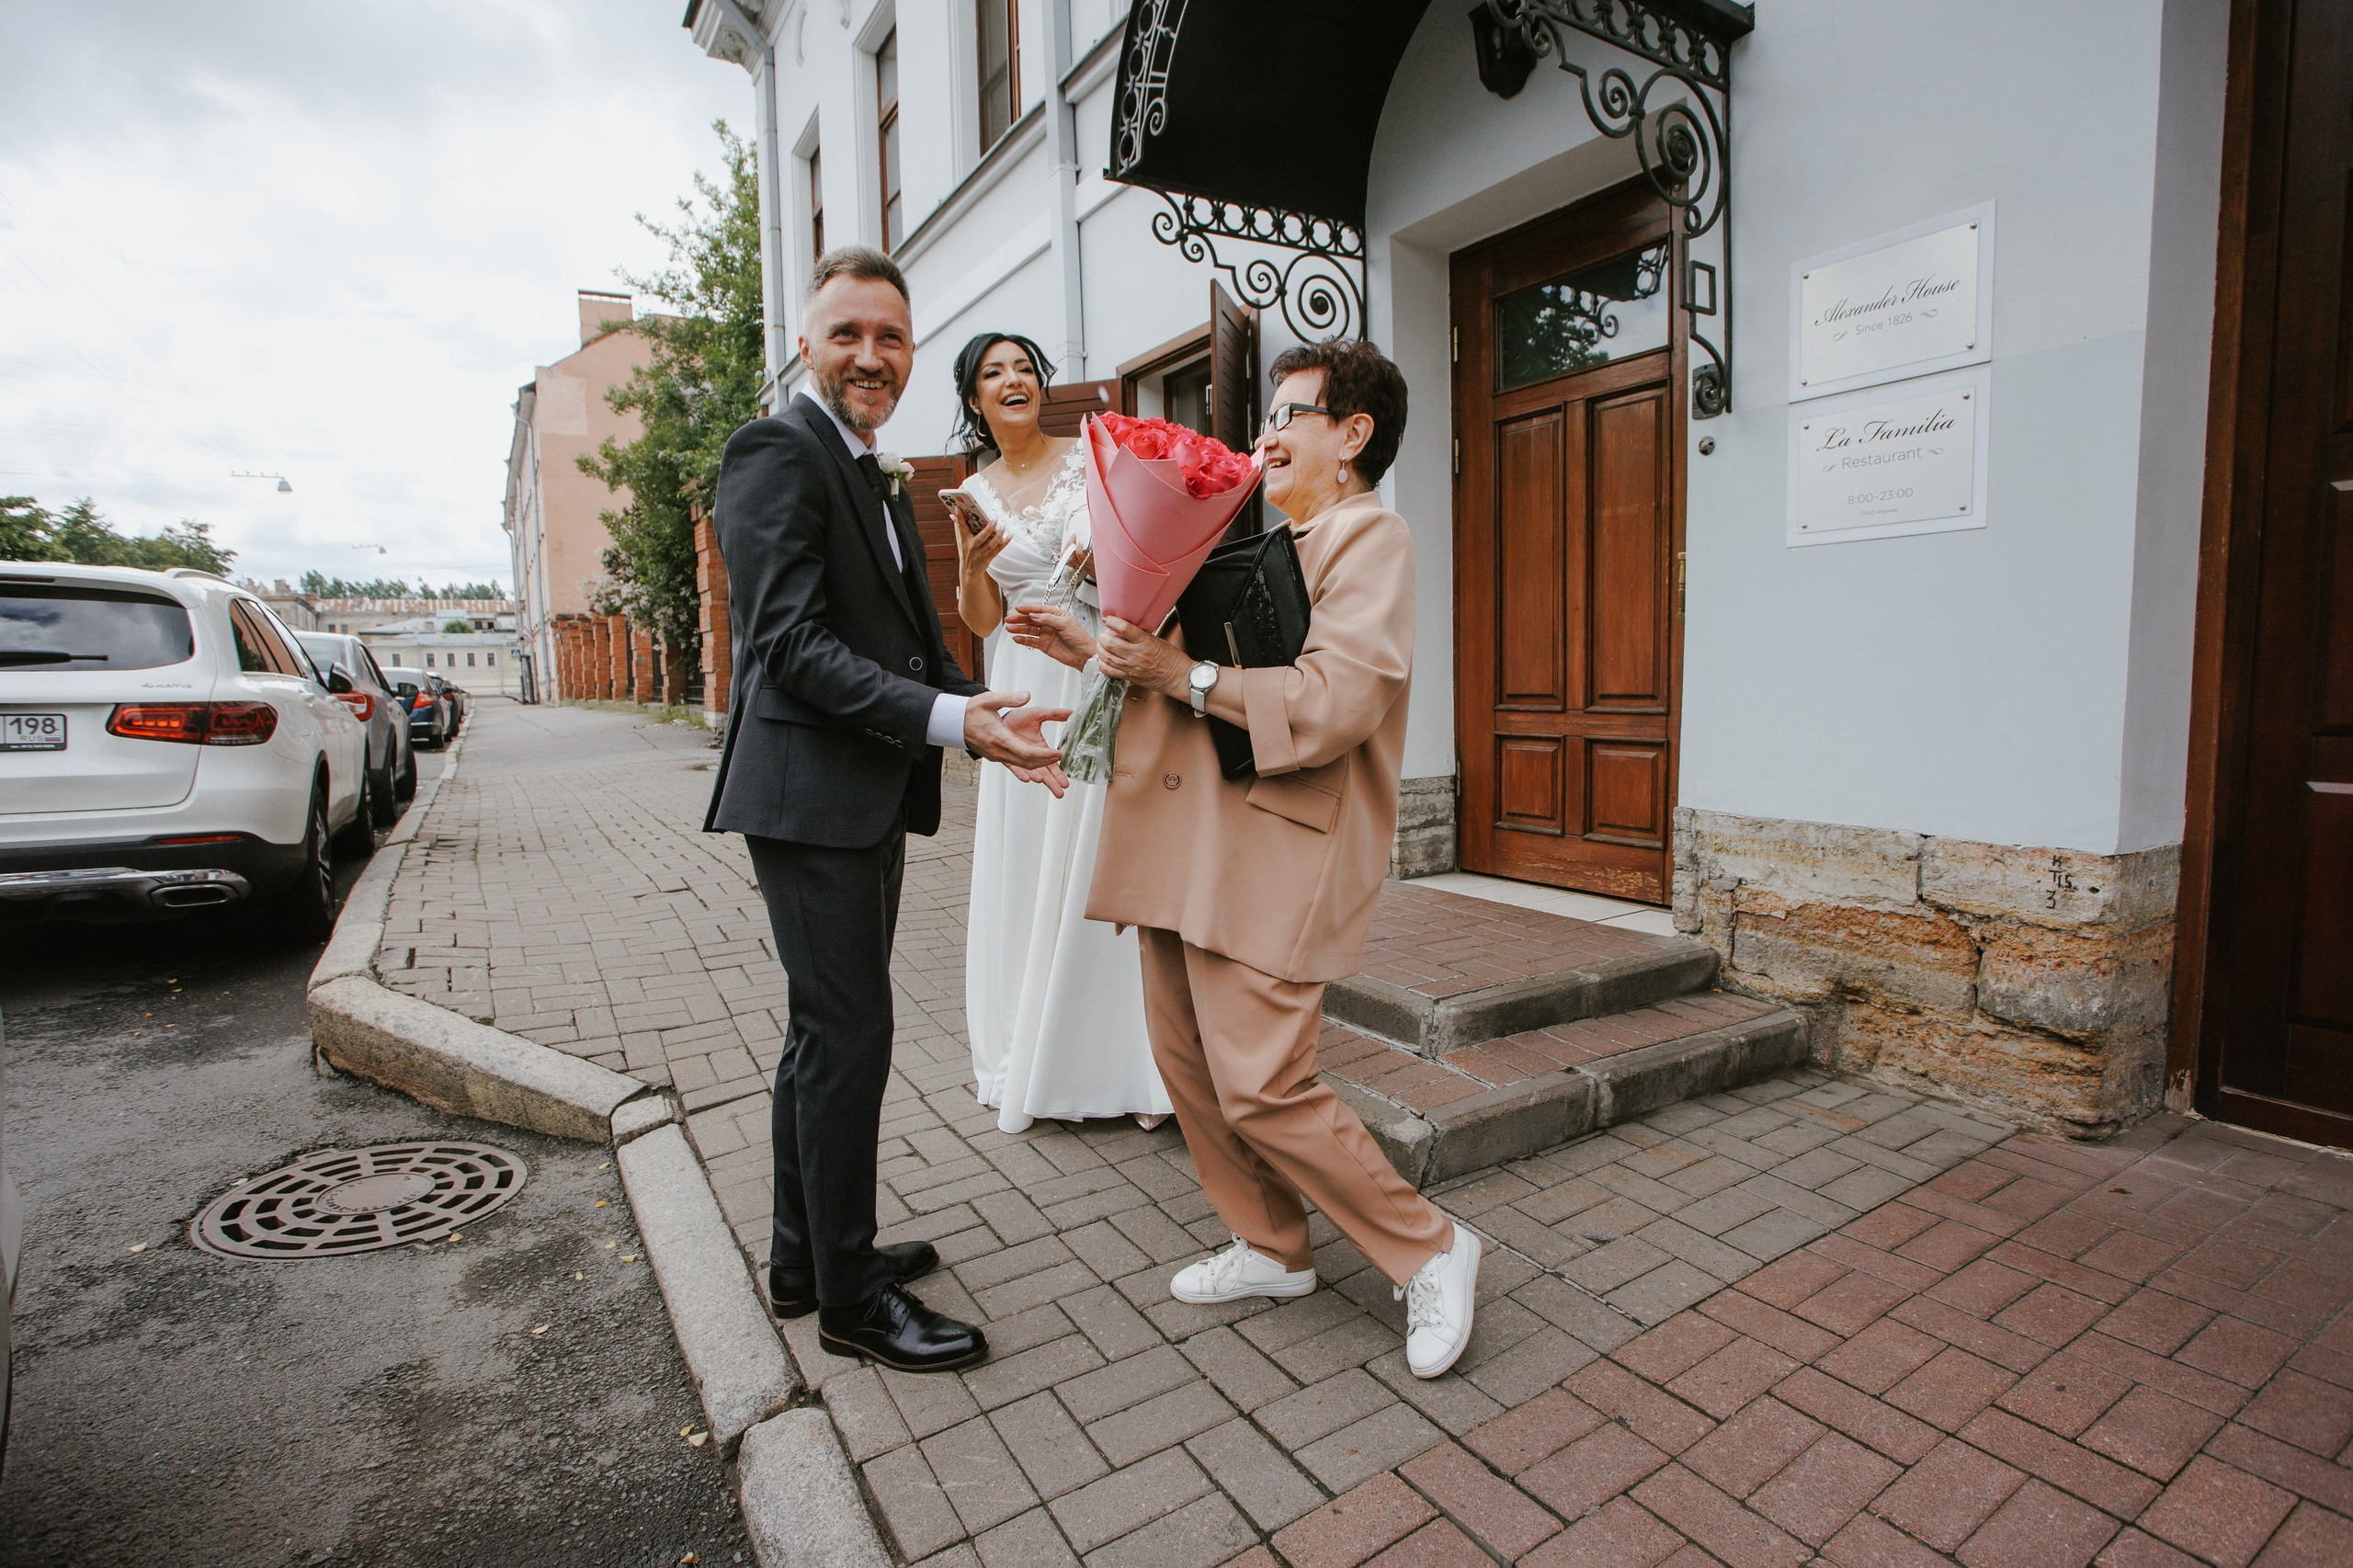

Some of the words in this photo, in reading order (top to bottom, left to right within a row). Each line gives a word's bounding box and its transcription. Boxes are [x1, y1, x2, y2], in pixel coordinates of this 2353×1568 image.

[1814, 285, 1898, 327] Alexander
[1901, 273, 1961, 303] House
[1855, 322, 1883, 335] Since
[1887, 312, 1913, 327] 1826
[1815, 426, 1851, 452] La
[1858, 408, 1956, 445] Familia
[1841, 446, 1923, 470] Restaurant
[1847, 487, 1914, 506] 8:00-23:00
[8, 717, 56, 735] 198
